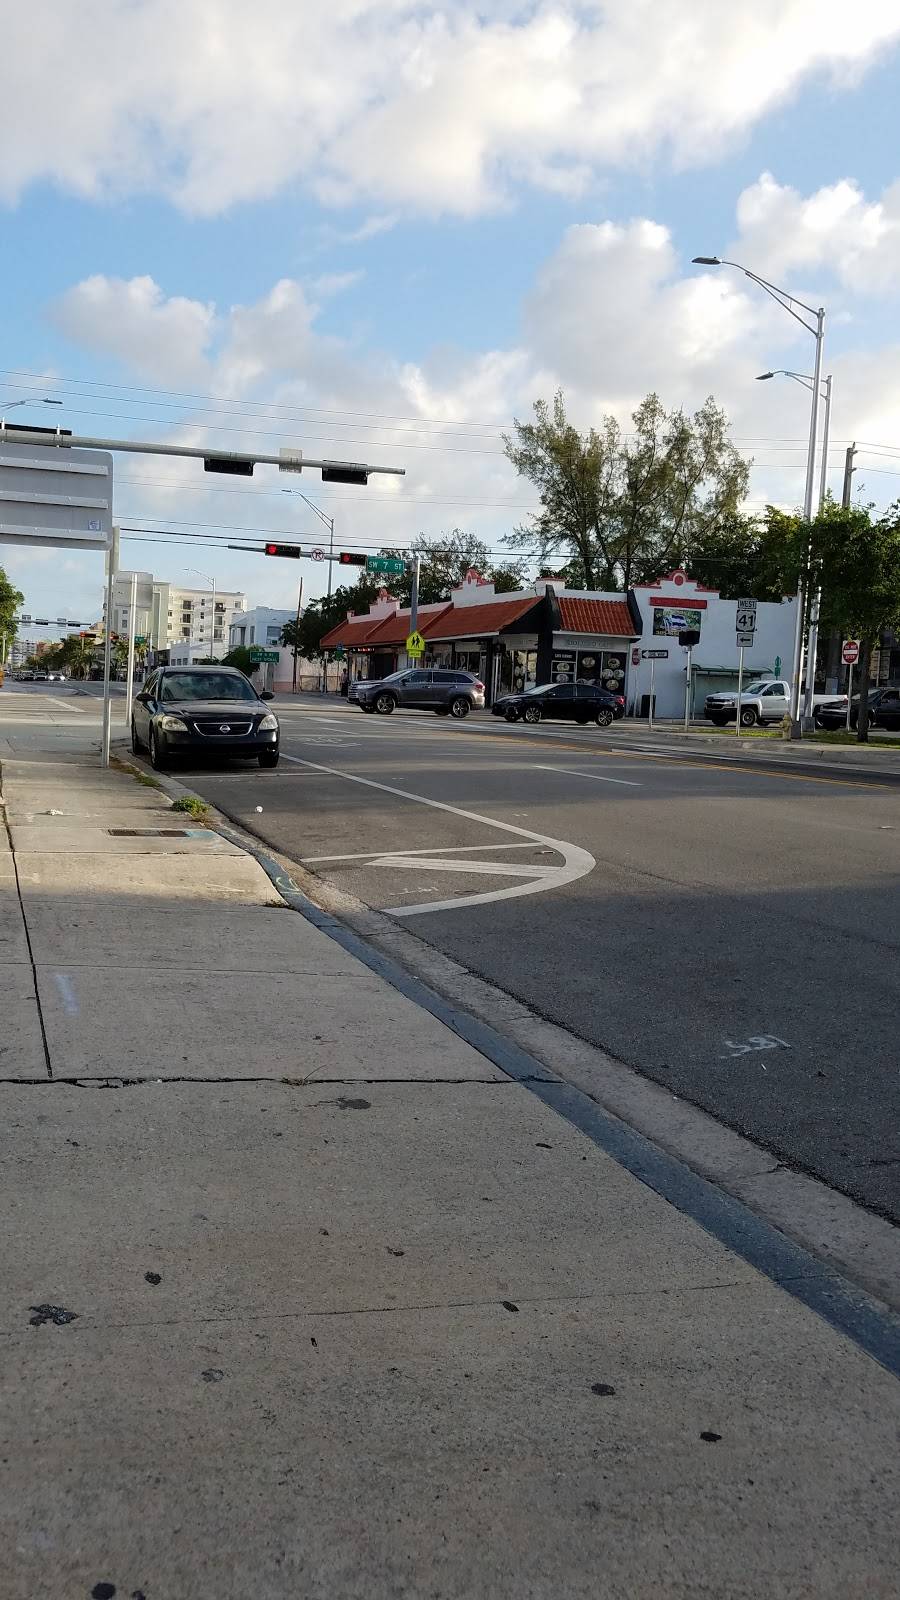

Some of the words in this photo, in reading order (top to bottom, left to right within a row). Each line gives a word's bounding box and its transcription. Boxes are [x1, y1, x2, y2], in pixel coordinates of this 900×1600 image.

[383, 561, 389, 569] 7
[739, 600, 755, 608] WEST
[738, 614, 754, 627] 41
